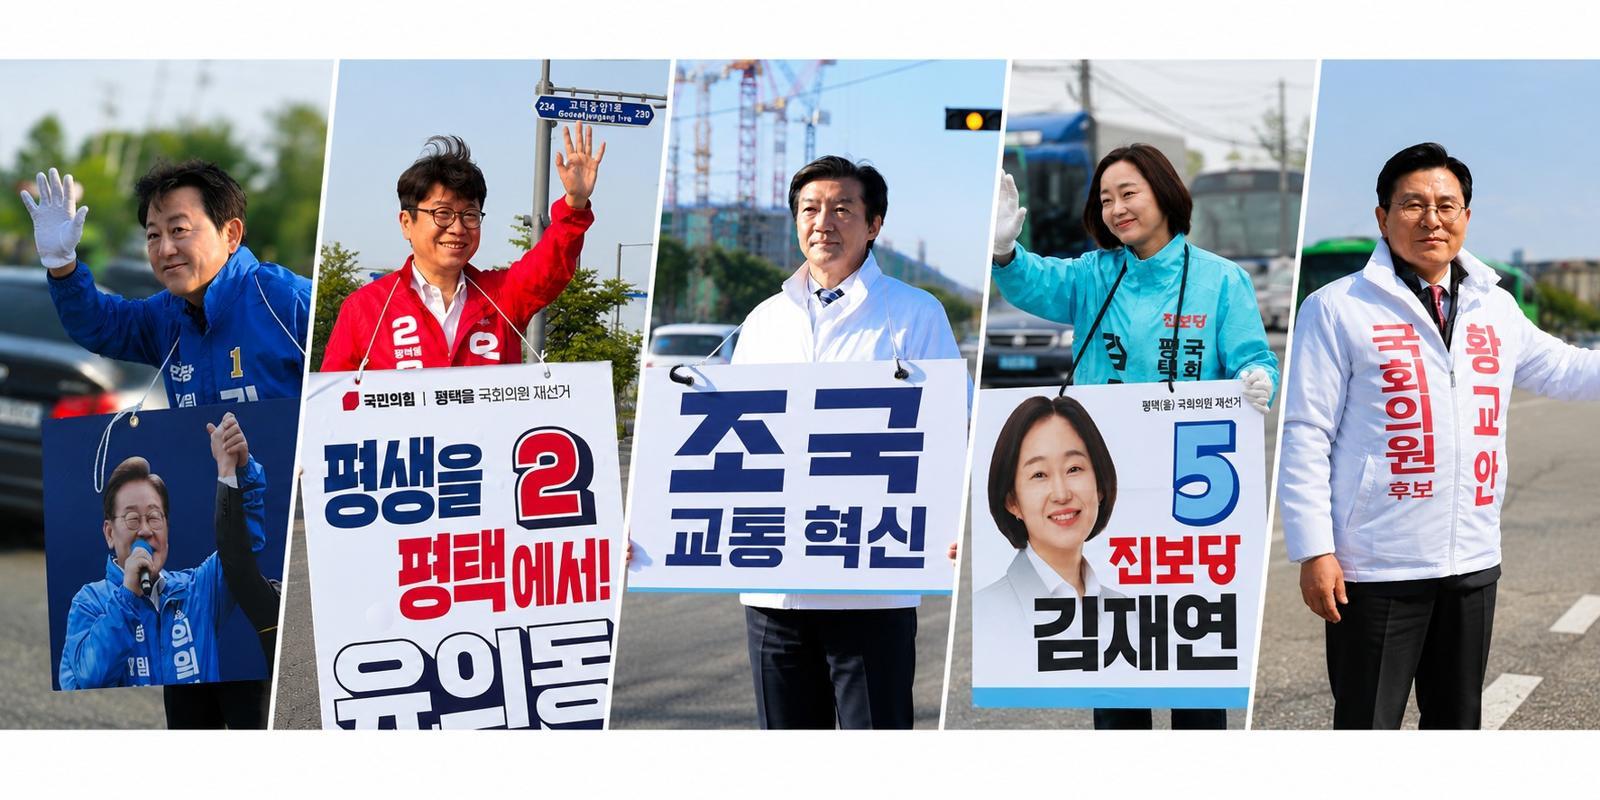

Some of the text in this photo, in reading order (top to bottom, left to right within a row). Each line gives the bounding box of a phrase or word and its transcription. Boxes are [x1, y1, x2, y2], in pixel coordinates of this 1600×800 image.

[539, 101, 555, 111] 234
[635, 110, 650, 119] 230
[392, 315, 420, 346] 2
[1163, 312, 1208, 329] 진보당
[230, 347, 244, 379] 1
[364, 384, 571, 409] 국민의힘 평택을 국회의원 재선거
[1215, 396, 1242, 408] 재선거
[1372, 323, 1436, 475] 국회의원
[1465, 323, 1502, 507] 황교안
[669, 387, 924, 494] 조국
[324, 436, 484, 529] 평생을
[513, 425, 597, 531] 2
[1172, 419, 1240, 527] 5
[1388, 480, 1434, 501] 후보
[665, 505, 927, 569] 교통 혁신
[1109, 534, 1241, 586] 진보당
[1034, 593, 1238, 672] 김재연
[333, 618, 614, 730] 유의동
